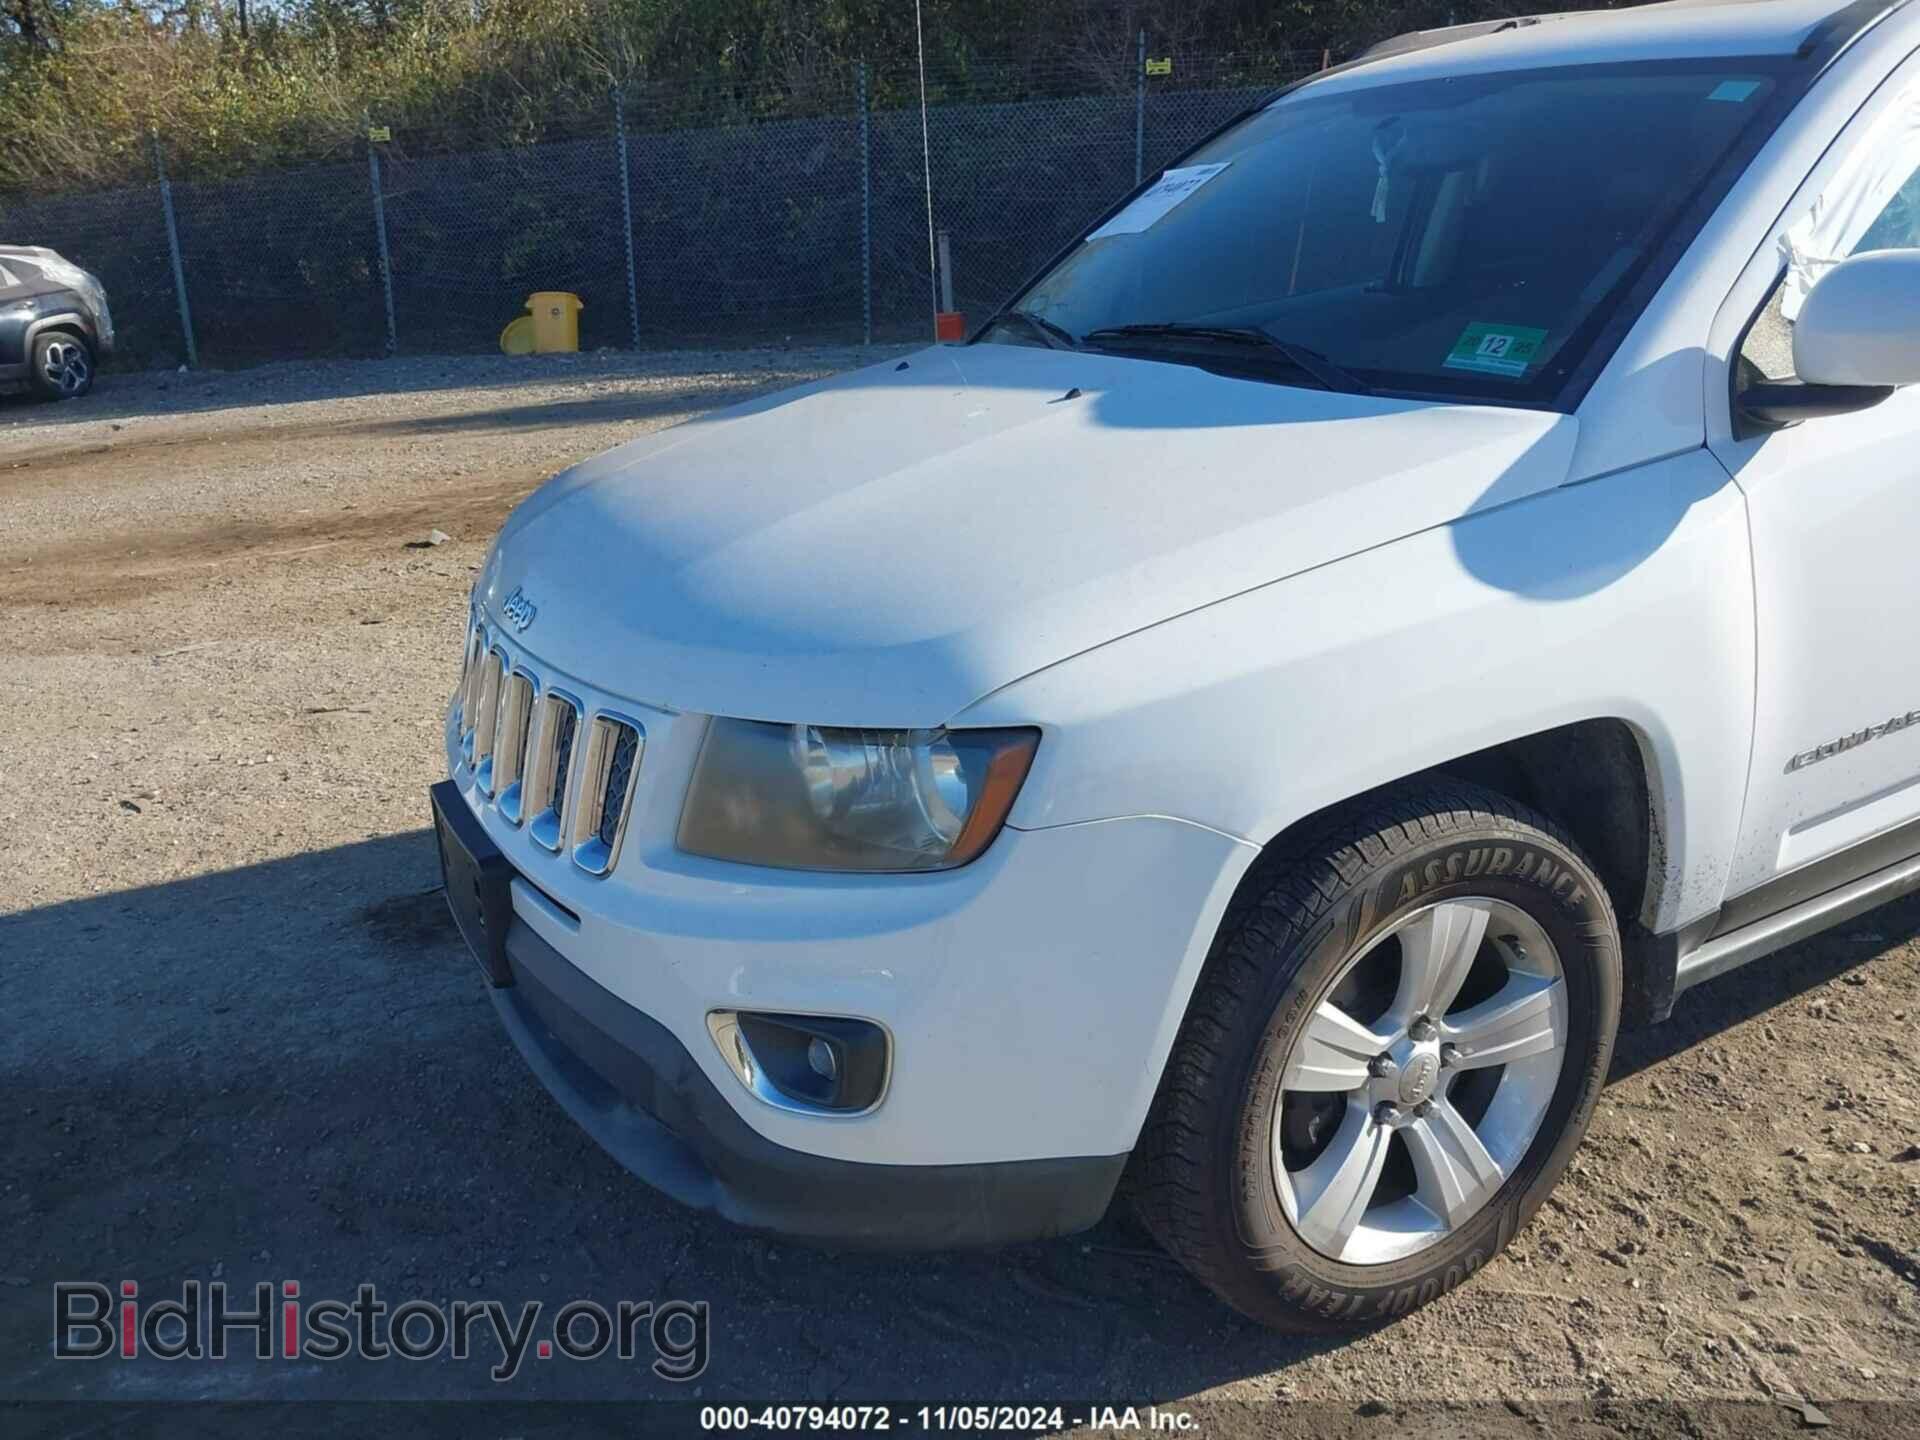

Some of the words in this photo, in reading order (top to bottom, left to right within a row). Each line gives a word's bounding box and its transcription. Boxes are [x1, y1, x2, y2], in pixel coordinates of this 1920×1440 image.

[1484, 335, 1508, 354] 12
[503, 584, 537, 634] Jeep
[1397, 847, 1588, 906] ASSURANCE
